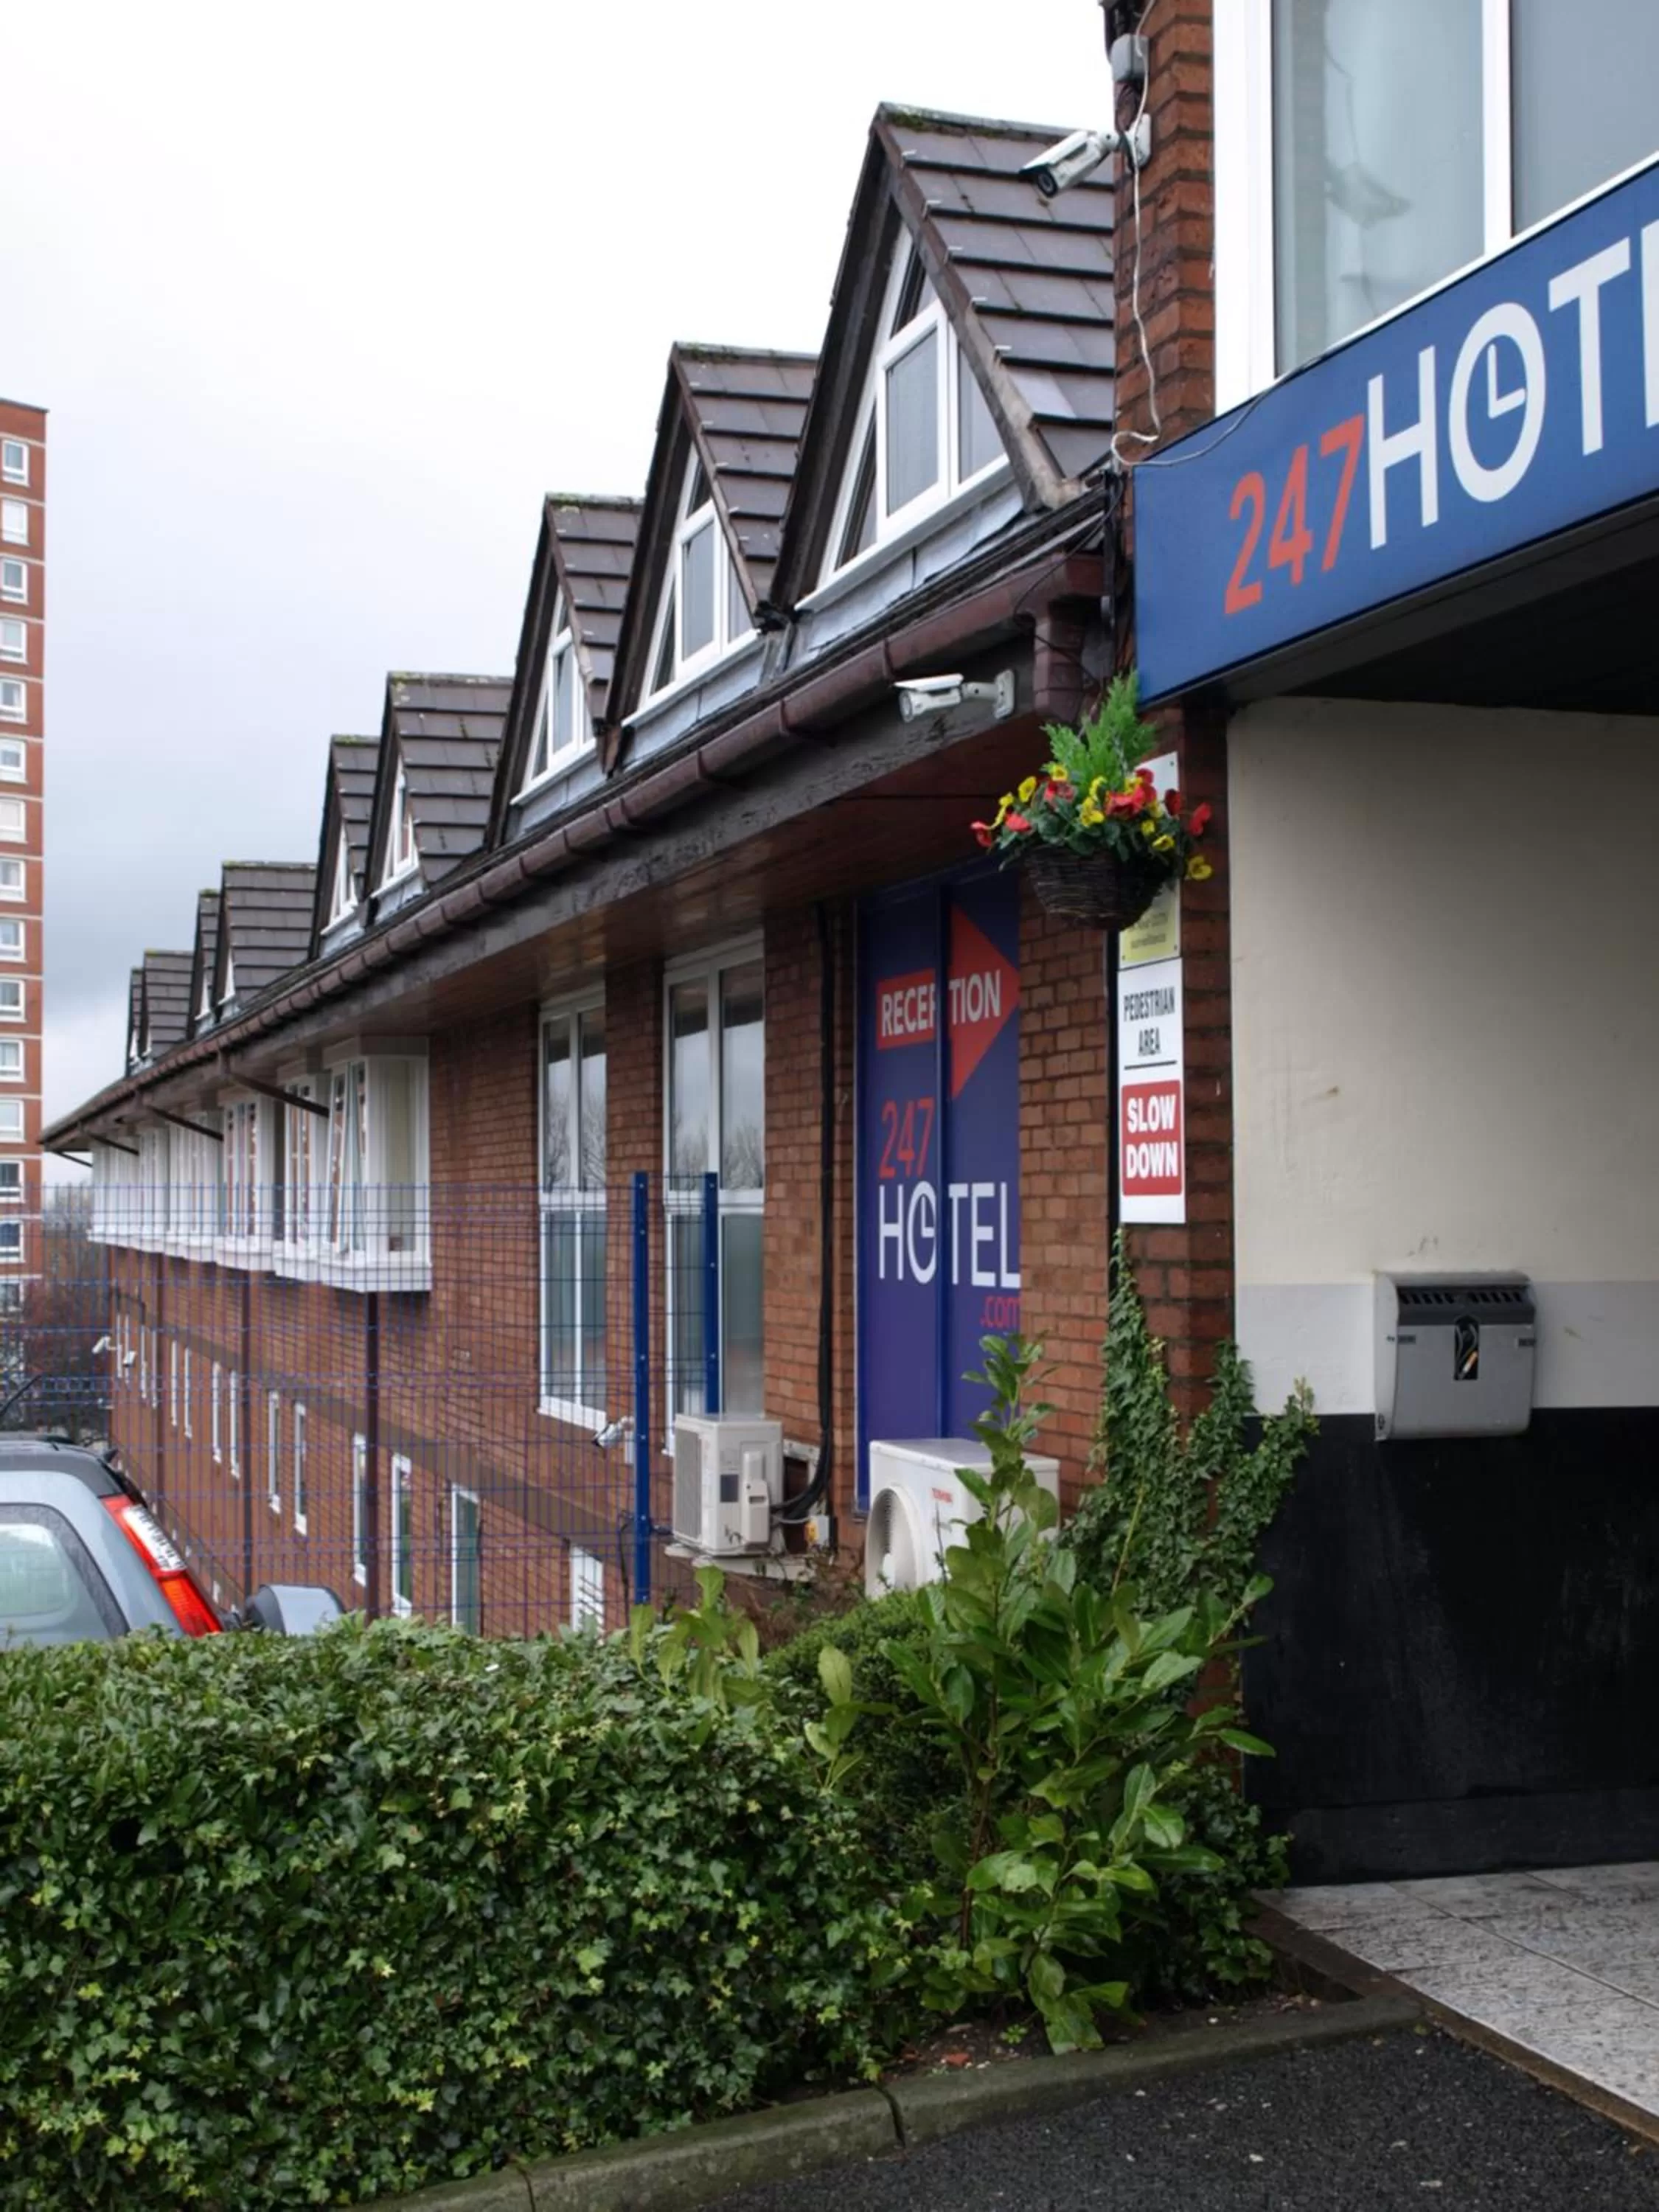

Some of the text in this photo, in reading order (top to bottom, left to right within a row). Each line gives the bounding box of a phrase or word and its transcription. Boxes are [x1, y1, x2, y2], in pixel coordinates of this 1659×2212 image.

[1124, 987, 1175, 1022] PEDESTRIAN
[1138, 1027, 1161, 1057] AREA
[1127, 1095, 1176, 1133] SLOW
[880, 1097, 934, 1178] 247
[1126, 1141, 1178, 1178] DOWN
[879, 1180, 1021, 1288] HOTEL
